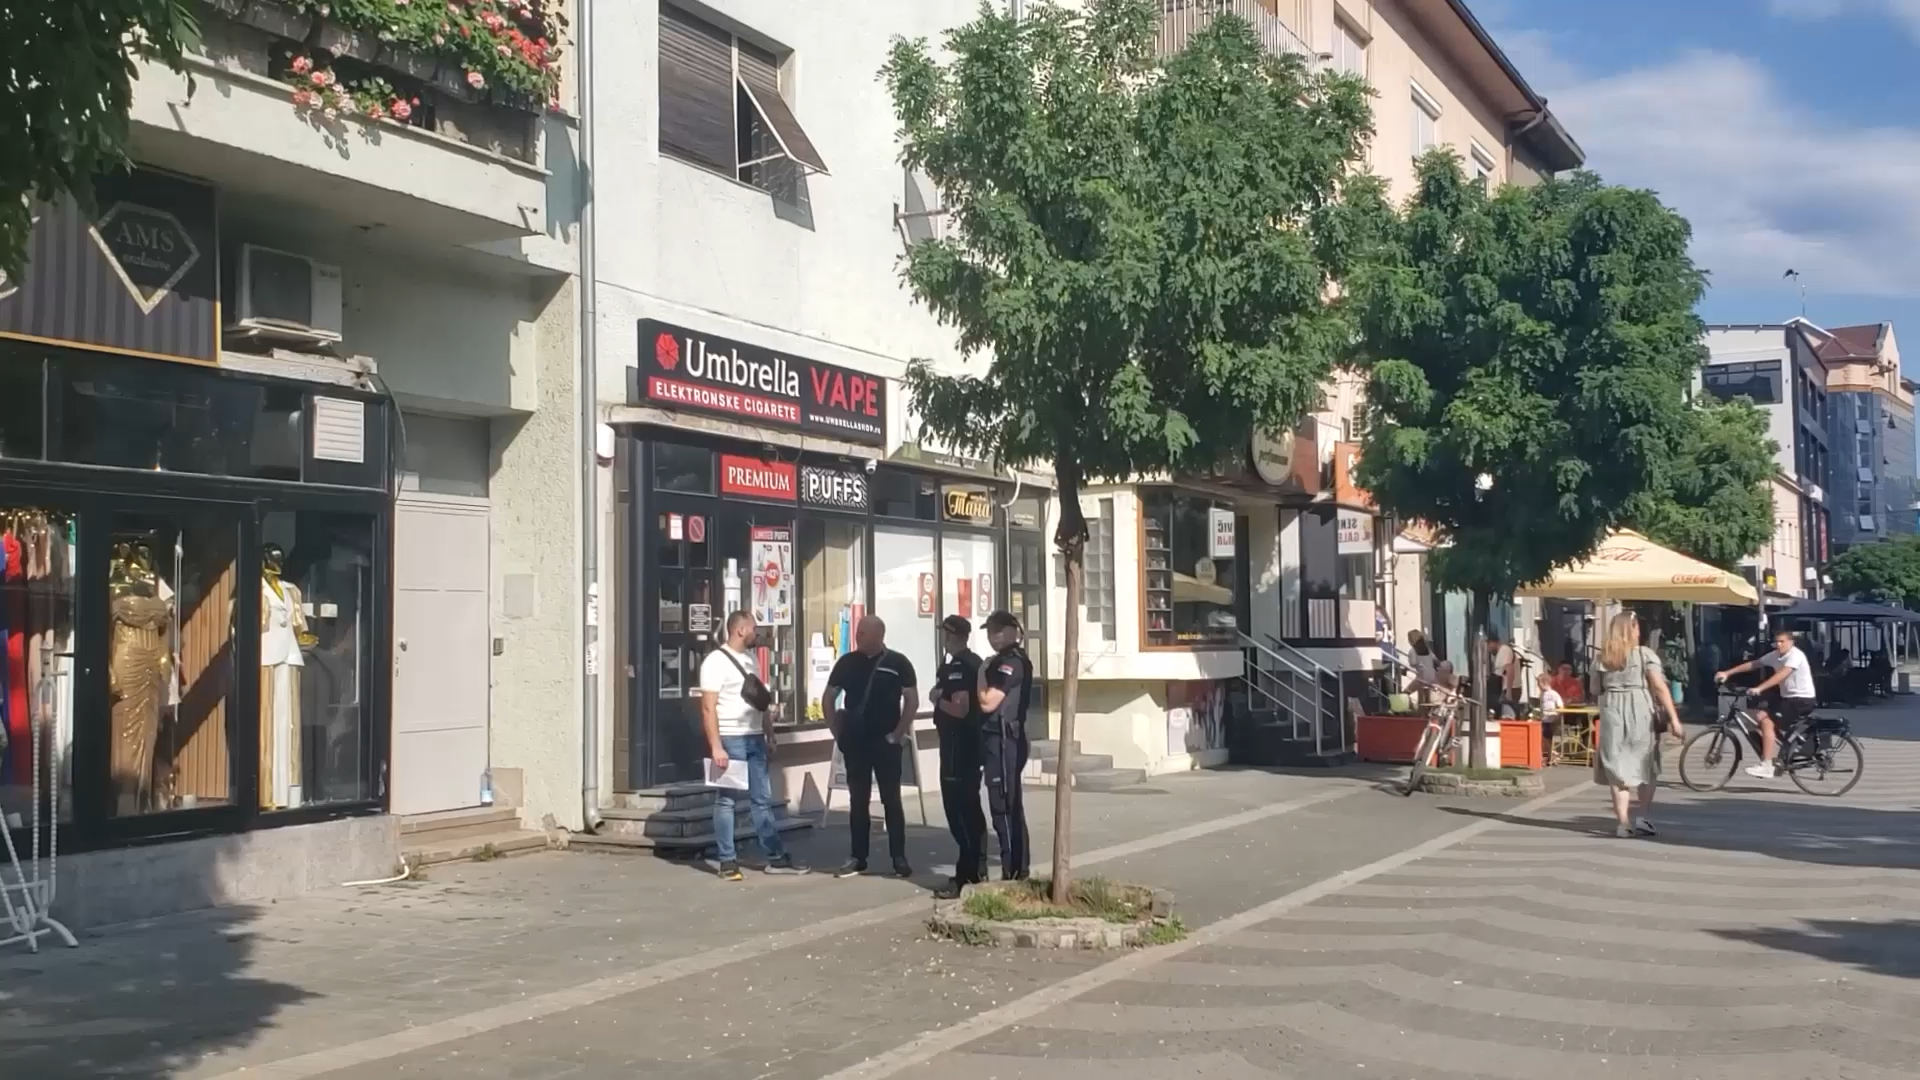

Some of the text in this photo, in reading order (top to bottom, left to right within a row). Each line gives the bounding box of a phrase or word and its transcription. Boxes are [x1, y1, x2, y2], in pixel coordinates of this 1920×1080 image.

[116, 221, 174, 252] AMS
[685, 337, 800, 397] Umbrella
[655, 381, 796, 420] ELEKTRONSKE CIGARETE
[809, 366, 878, 417] VAPE
[728, 466, 790, 491] PREMIUM
[809, 473, 862, 503] PUFFS
